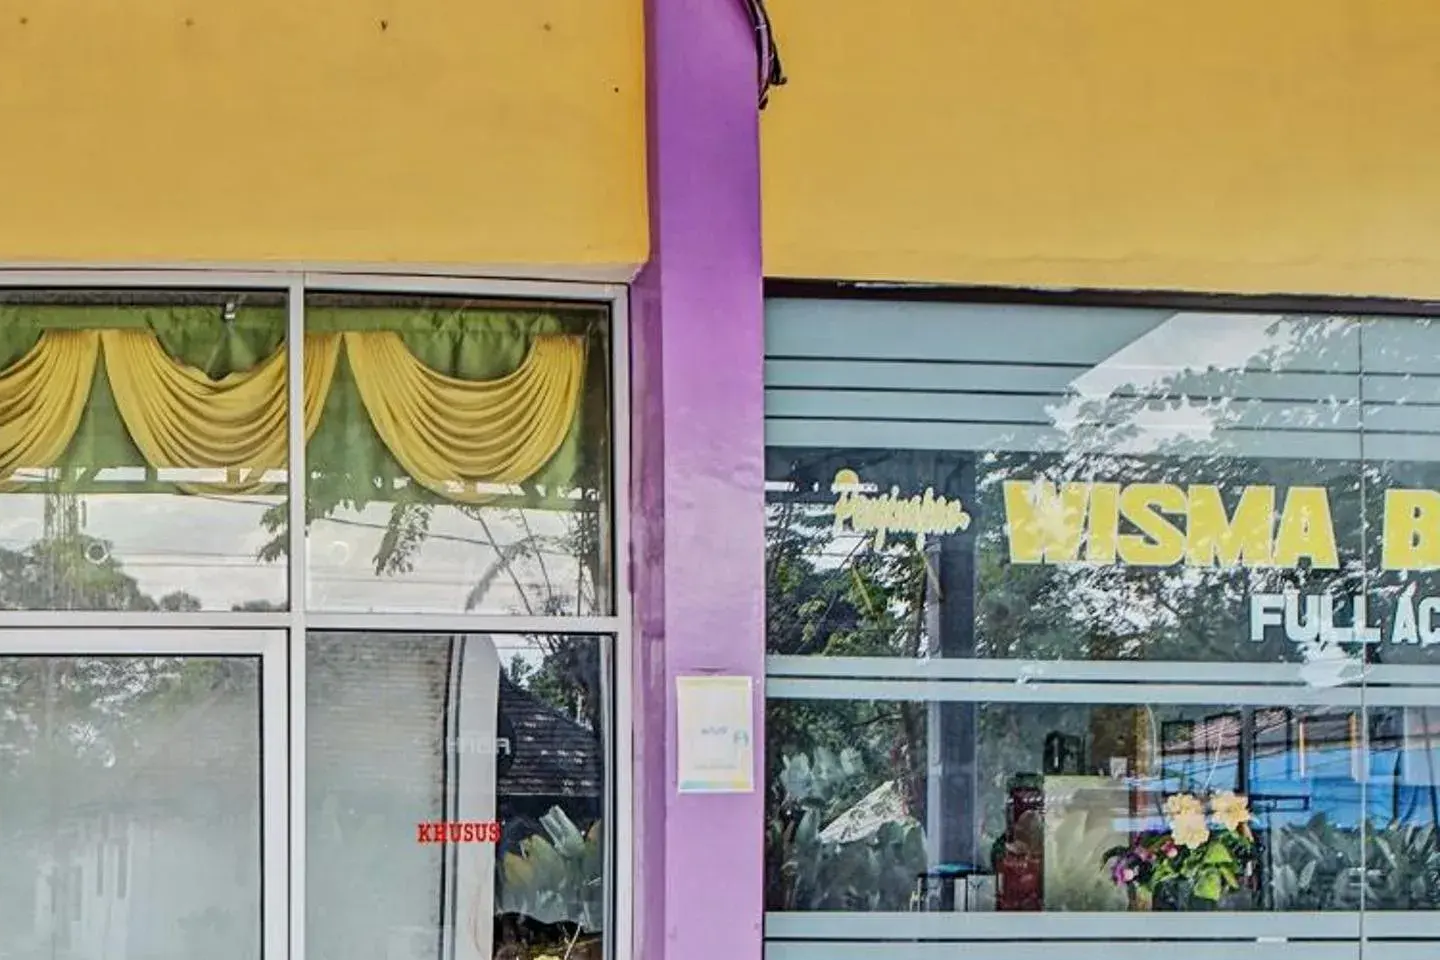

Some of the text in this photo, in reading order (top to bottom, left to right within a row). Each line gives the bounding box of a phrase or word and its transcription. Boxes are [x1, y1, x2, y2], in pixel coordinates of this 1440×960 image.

[1003, 479, 1339, 569] WISMA
[1250, 594, 1381, 644] FULL
[417, 823, 501, 843] KHUSUS
